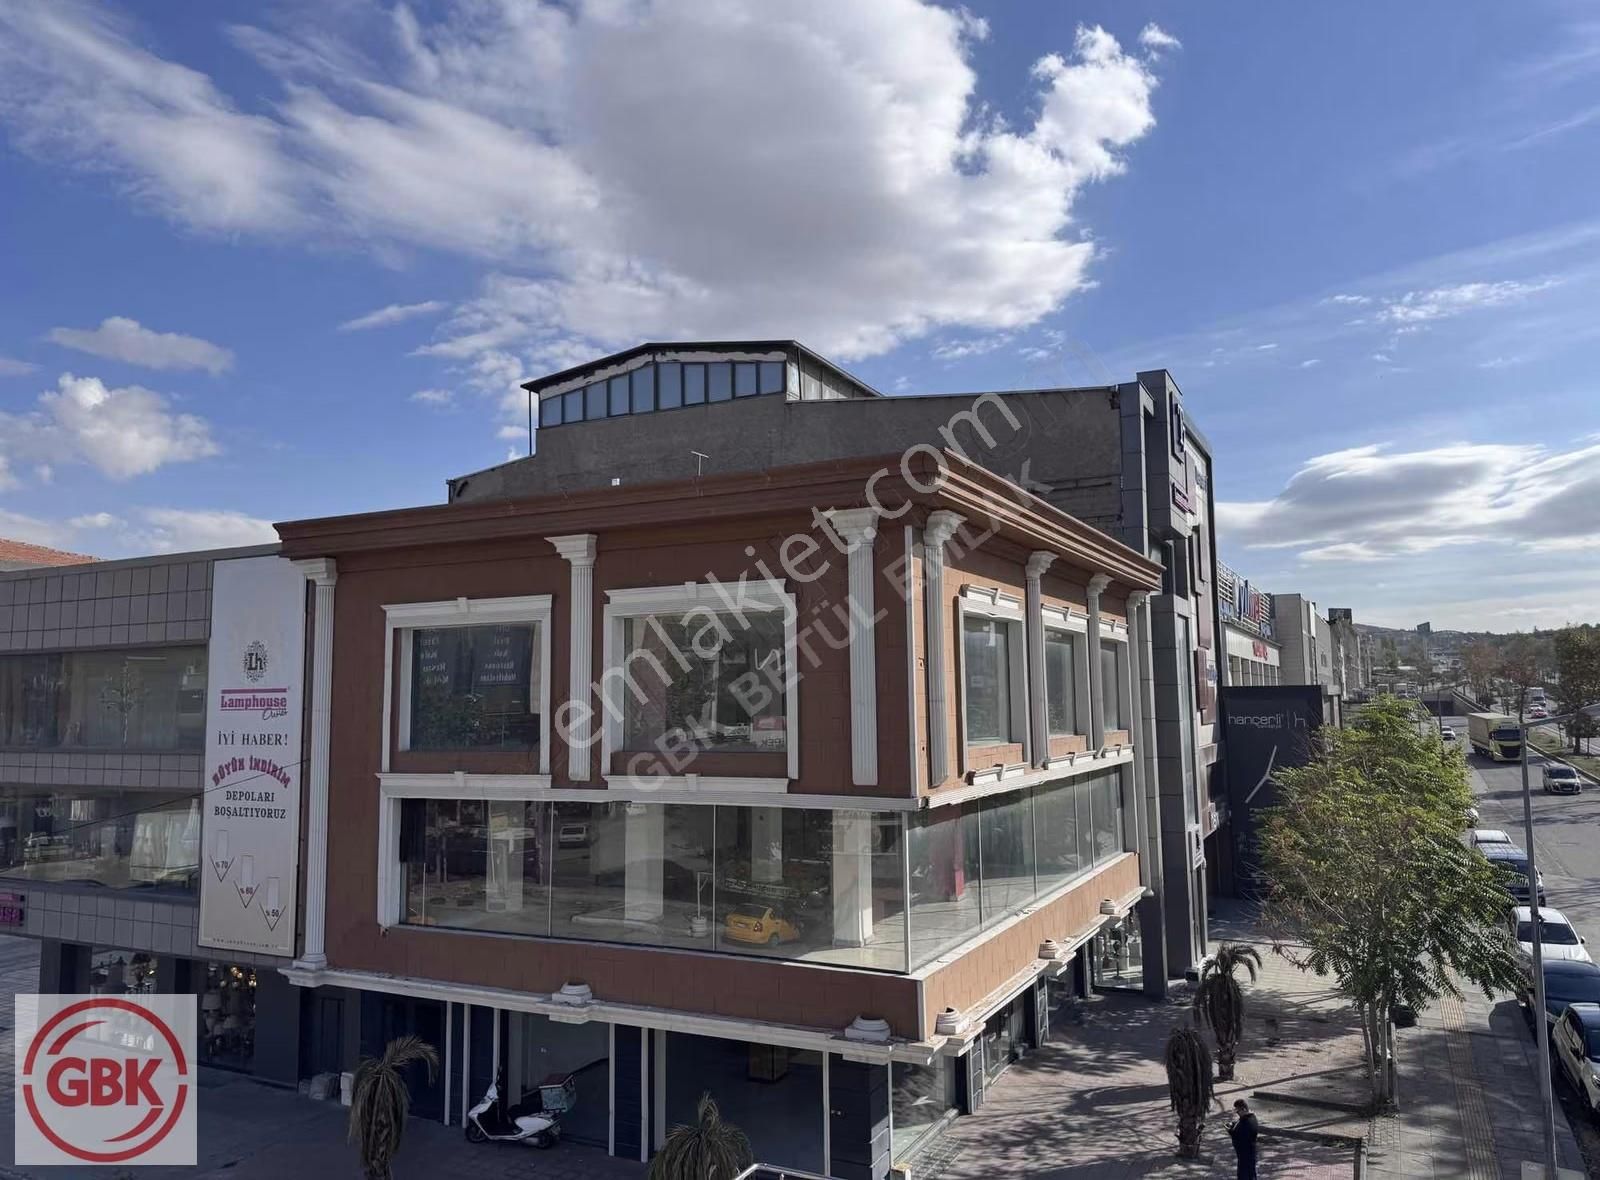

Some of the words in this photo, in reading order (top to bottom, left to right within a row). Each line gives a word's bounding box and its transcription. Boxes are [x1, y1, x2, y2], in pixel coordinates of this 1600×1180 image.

[220, 695, 287, 711] Lamphouse
[218, 730, 235, 746] İYİ
[241, 733, 288, 746] HABER!
[225, 790, 275, 802] DEPOLARI
[214, 805, 287, 820] BOŞALTIYORUZ
